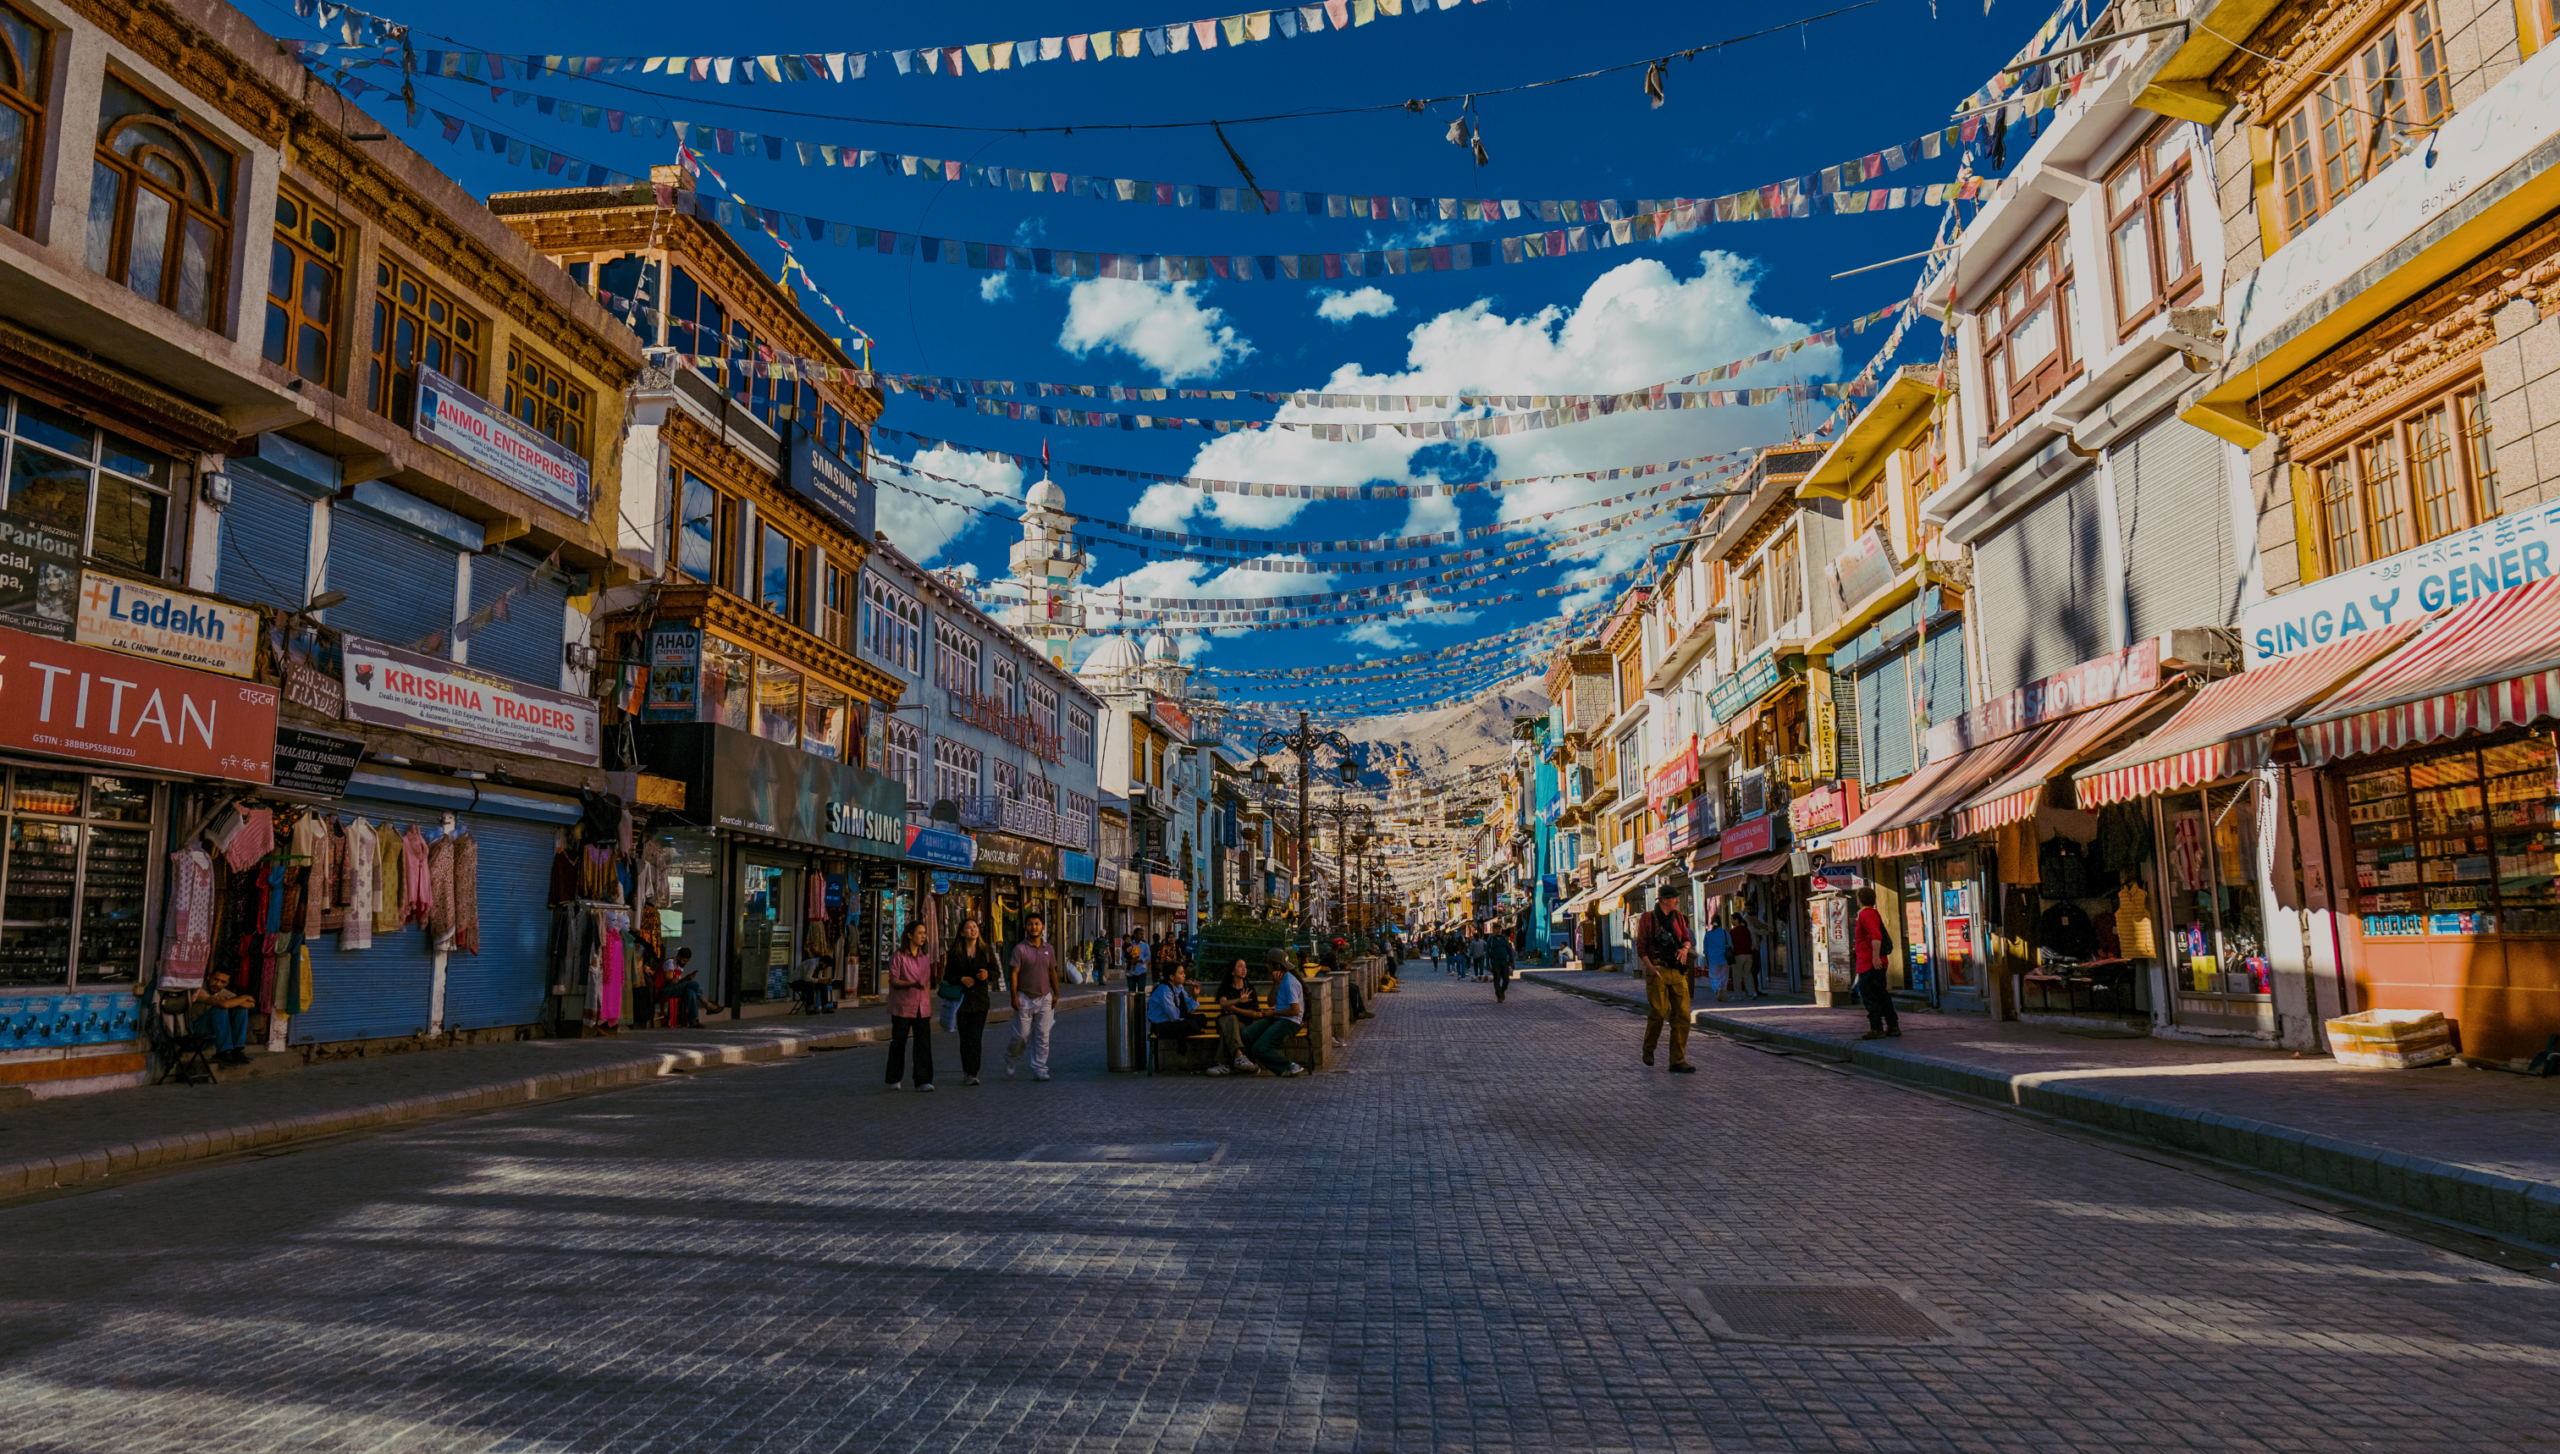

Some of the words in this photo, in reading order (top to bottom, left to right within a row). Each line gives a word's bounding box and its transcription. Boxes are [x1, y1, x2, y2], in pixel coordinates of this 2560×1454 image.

[437, 399, 490, 443] ANMOL
[493, 429, 575, 488] ENTERPRISES
[812, 449, 858, 499] SAMSUNG
[813, 476, 838, 502] Customer
[838, 494, 856, 515] Service
[0, 521, 79, 558] Parlour
[109, 585, 226, 643] Ladakh
[2255, 586, 2401, 660] SINGAY
[2417, 539, 2560, 614] GENER
[22, 617, 37, 628] Leh
[38, 621, 65, 634] Ladakh
[77, 615, 149, 645] CLINICAL
[156, 631, 252, 666] LABORATORY
[655, 634, 696, 649] AHAD
[112, 638, 128, 649] LAL
[131, 642, 160, 656] CHOWK
[161, 648, 181, 660] MAIN
[29, 661, 217, 751] TITAN
[384, 668, 483, 712] KRISHNA
[492, 695, 576, 733] TRADERS
[2005, 673, 2081, 726] FASHION
[2083, 651, 2141, 700] ZONE
[451, 708, 463, 717] LED
[32, 733, 58, 747] GSTIN
[275, 744, 318, 762] IMALAYAN
[316, 751, 356, 768] PASHMINA
[1821, 707, 1832, 767] HANDICRAFT
[294, 760, 324, 775] HOUSE
[829, 801, 902, 845] SAMSUNG
[979, 847, 1006, 864] ZANSKAR
[1006, 851, 1020, 866] ARTS
[1833, 901, 1842, 916] SIM
[1834, 920, 1843, 940] CARD
